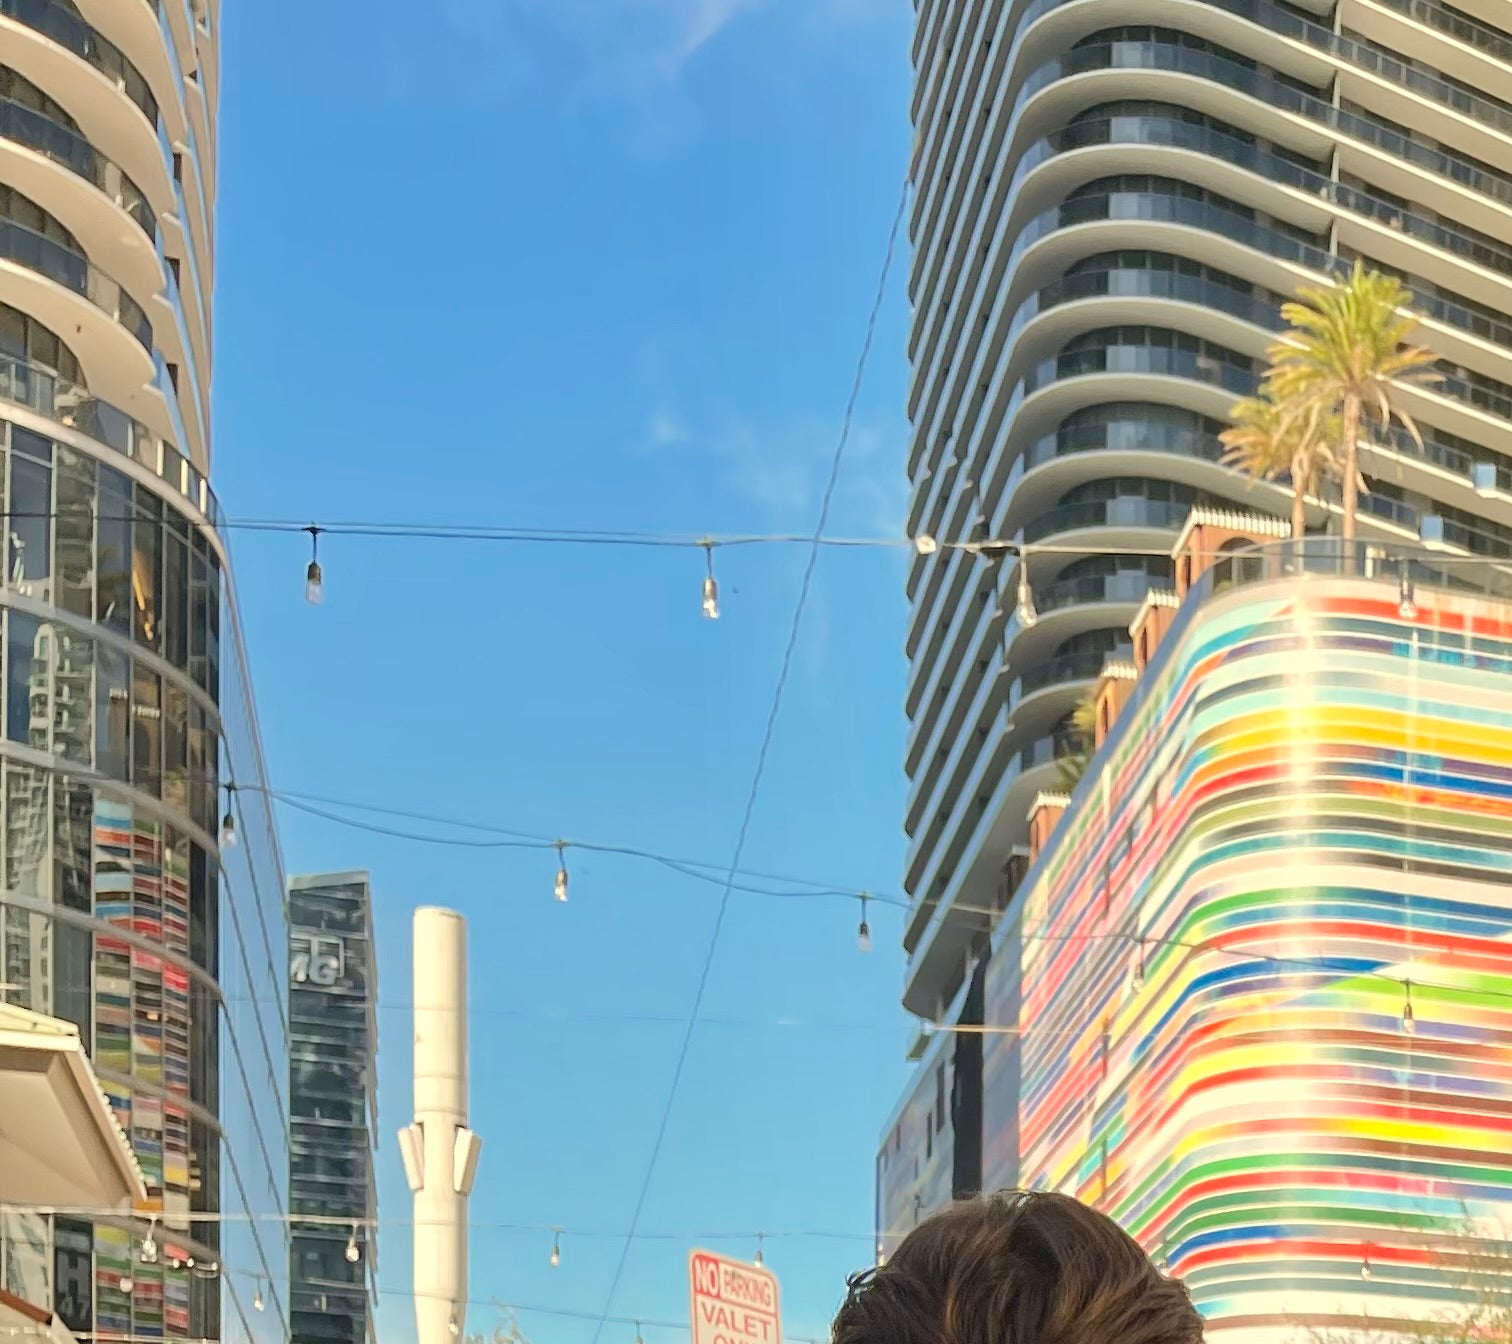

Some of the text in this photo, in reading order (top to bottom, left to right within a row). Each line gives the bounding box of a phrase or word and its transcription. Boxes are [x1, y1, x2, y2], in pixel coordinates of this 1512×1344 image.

[695, 1258, 771, 1307] NO PARKING
[700, 1302, 771, 1340] VALET
